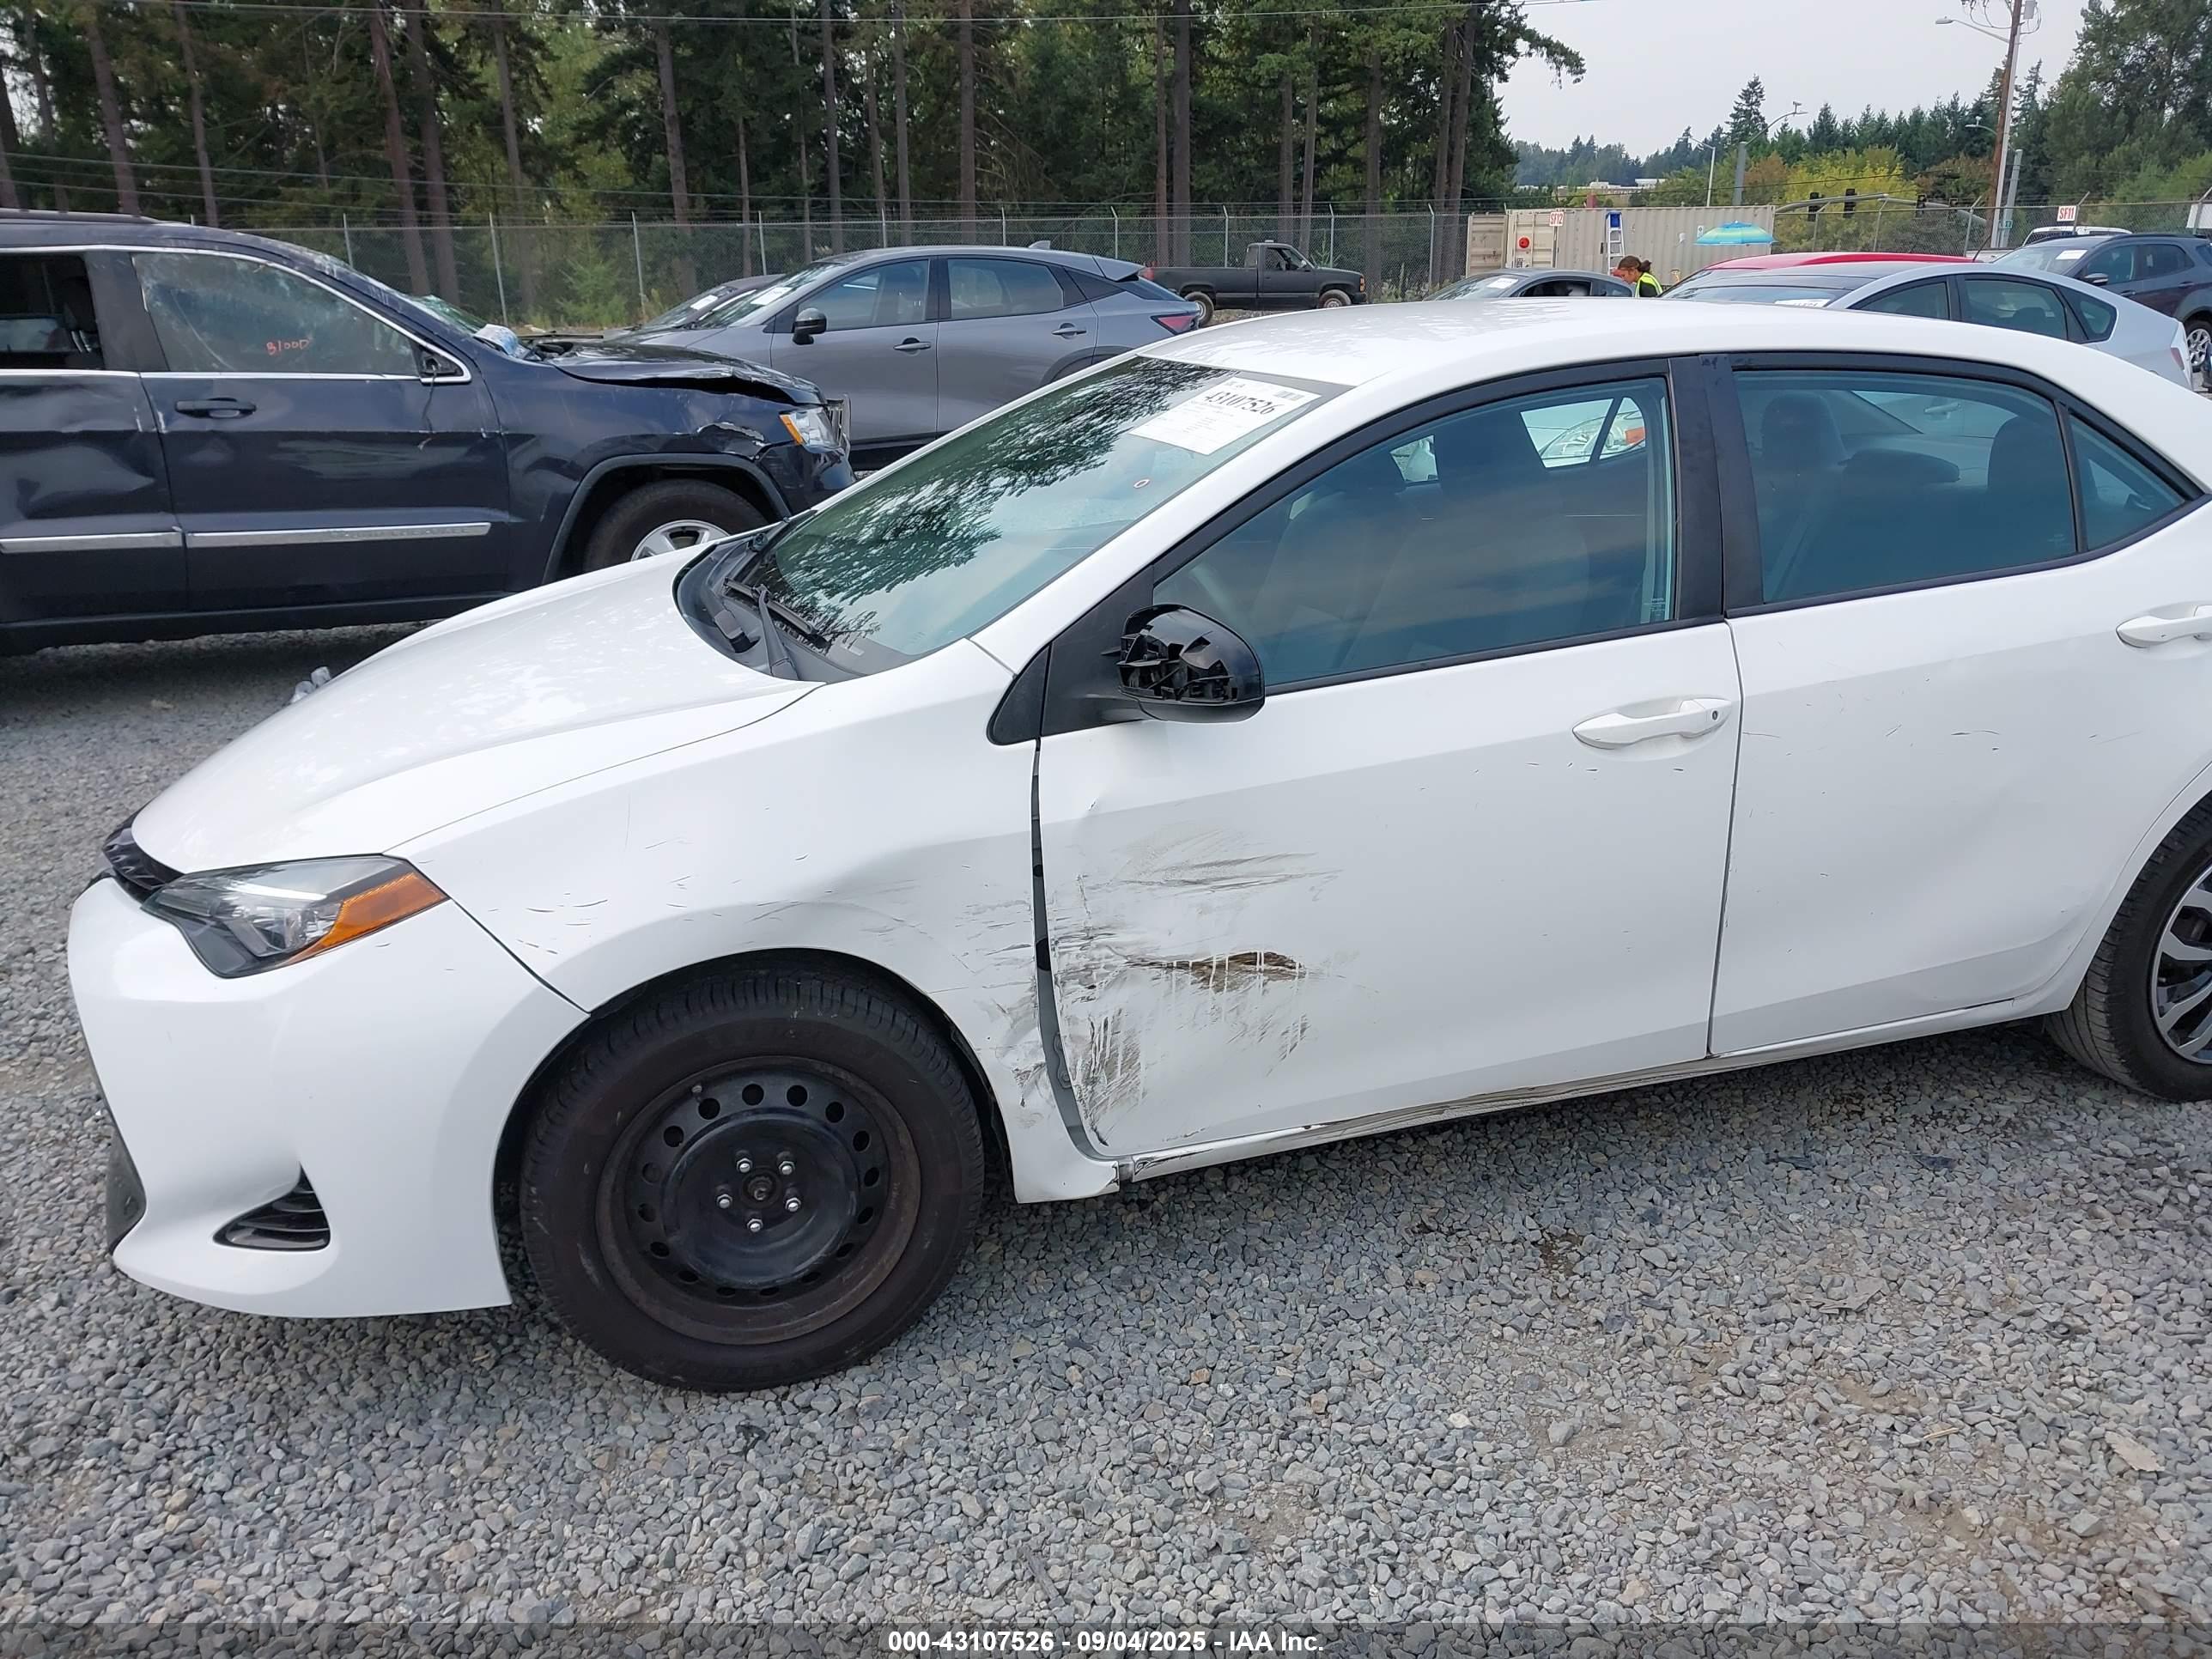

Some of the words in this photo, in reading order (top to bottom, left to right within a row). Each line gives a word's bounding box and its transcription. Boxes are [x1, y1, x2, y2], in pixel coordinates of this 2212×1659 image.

[1550, 213, 1564, 226] SF12
[2059, 207, 2075, 220] SF11
[1205, 391, 1283, 415] 43107526
